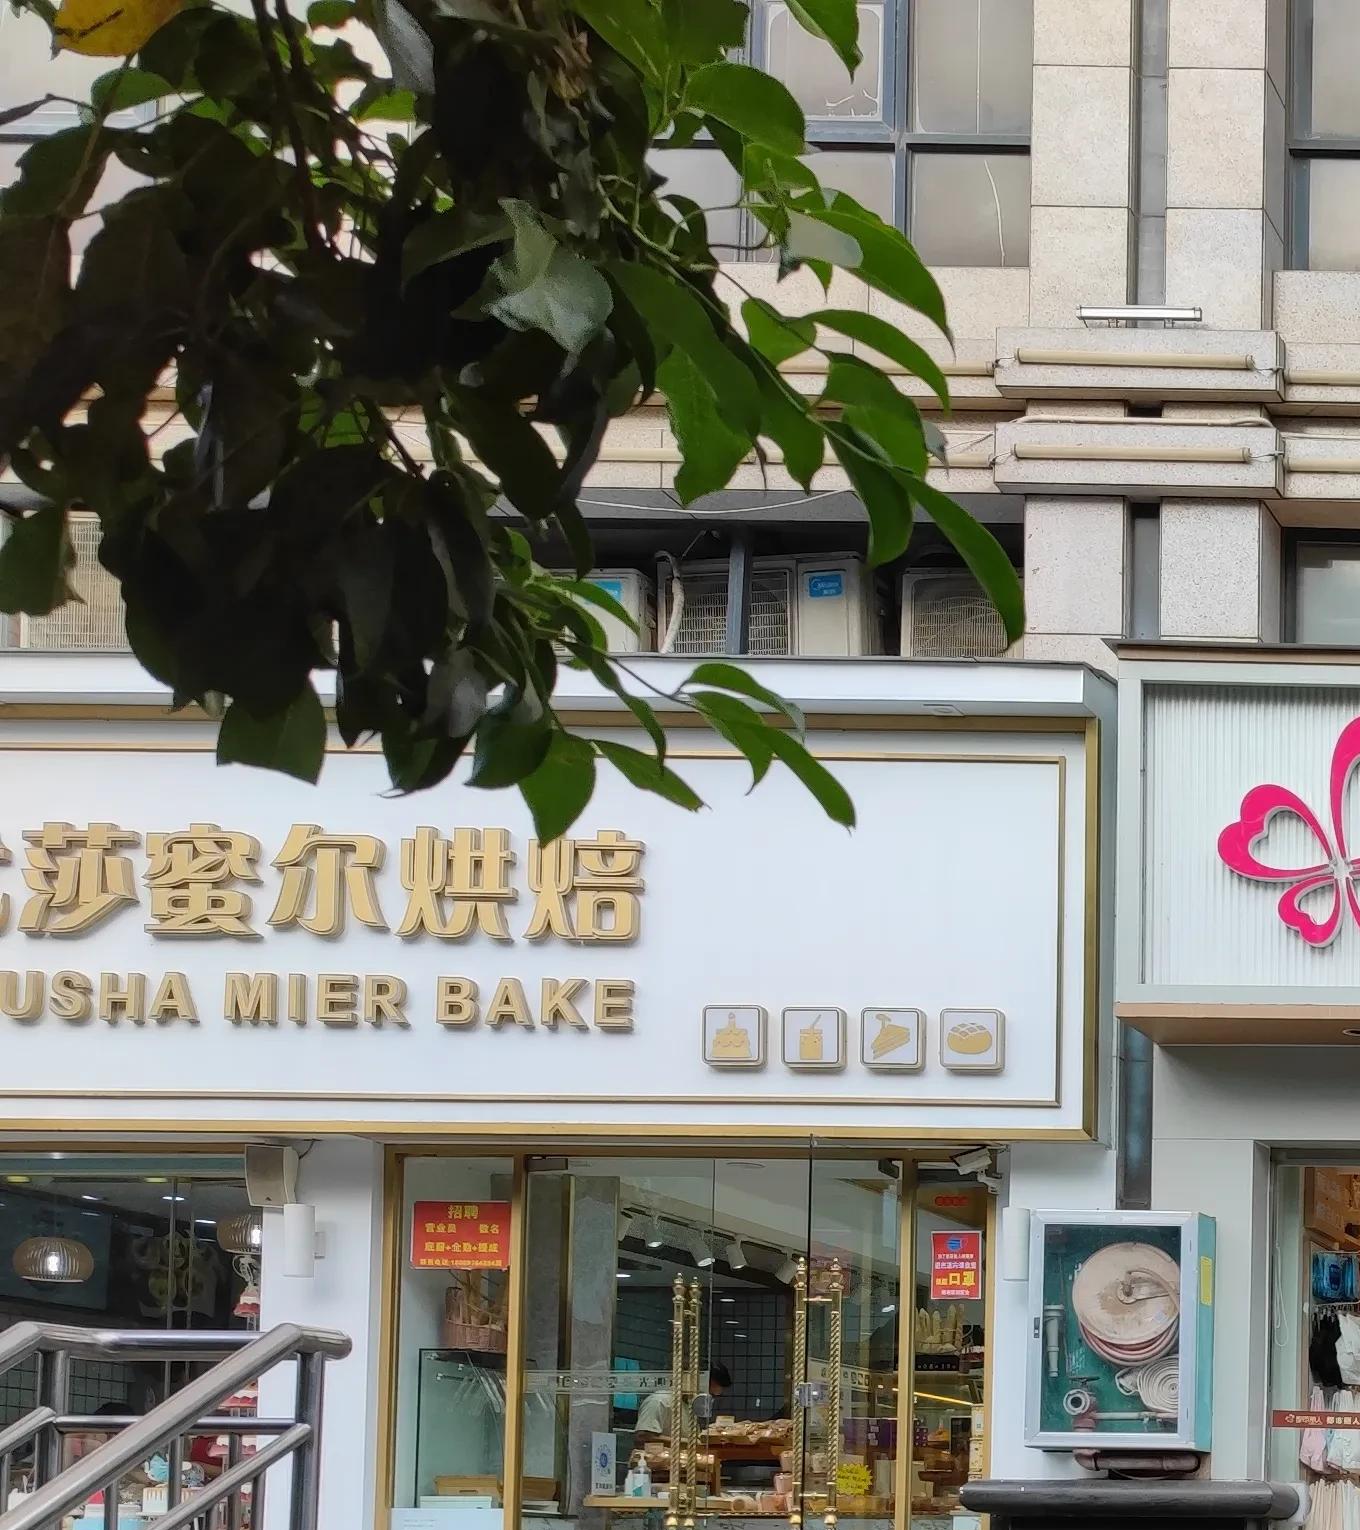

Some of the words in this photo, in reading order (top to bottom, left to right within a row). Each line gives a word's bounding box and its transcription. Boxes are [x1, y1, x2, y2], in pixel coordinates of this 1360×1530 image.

[0, 822, 647, 943] 莎蜜尔烘焙
[224, 972, 412, 1028] MIER
[436, 975, 636, 1031] BAKE
